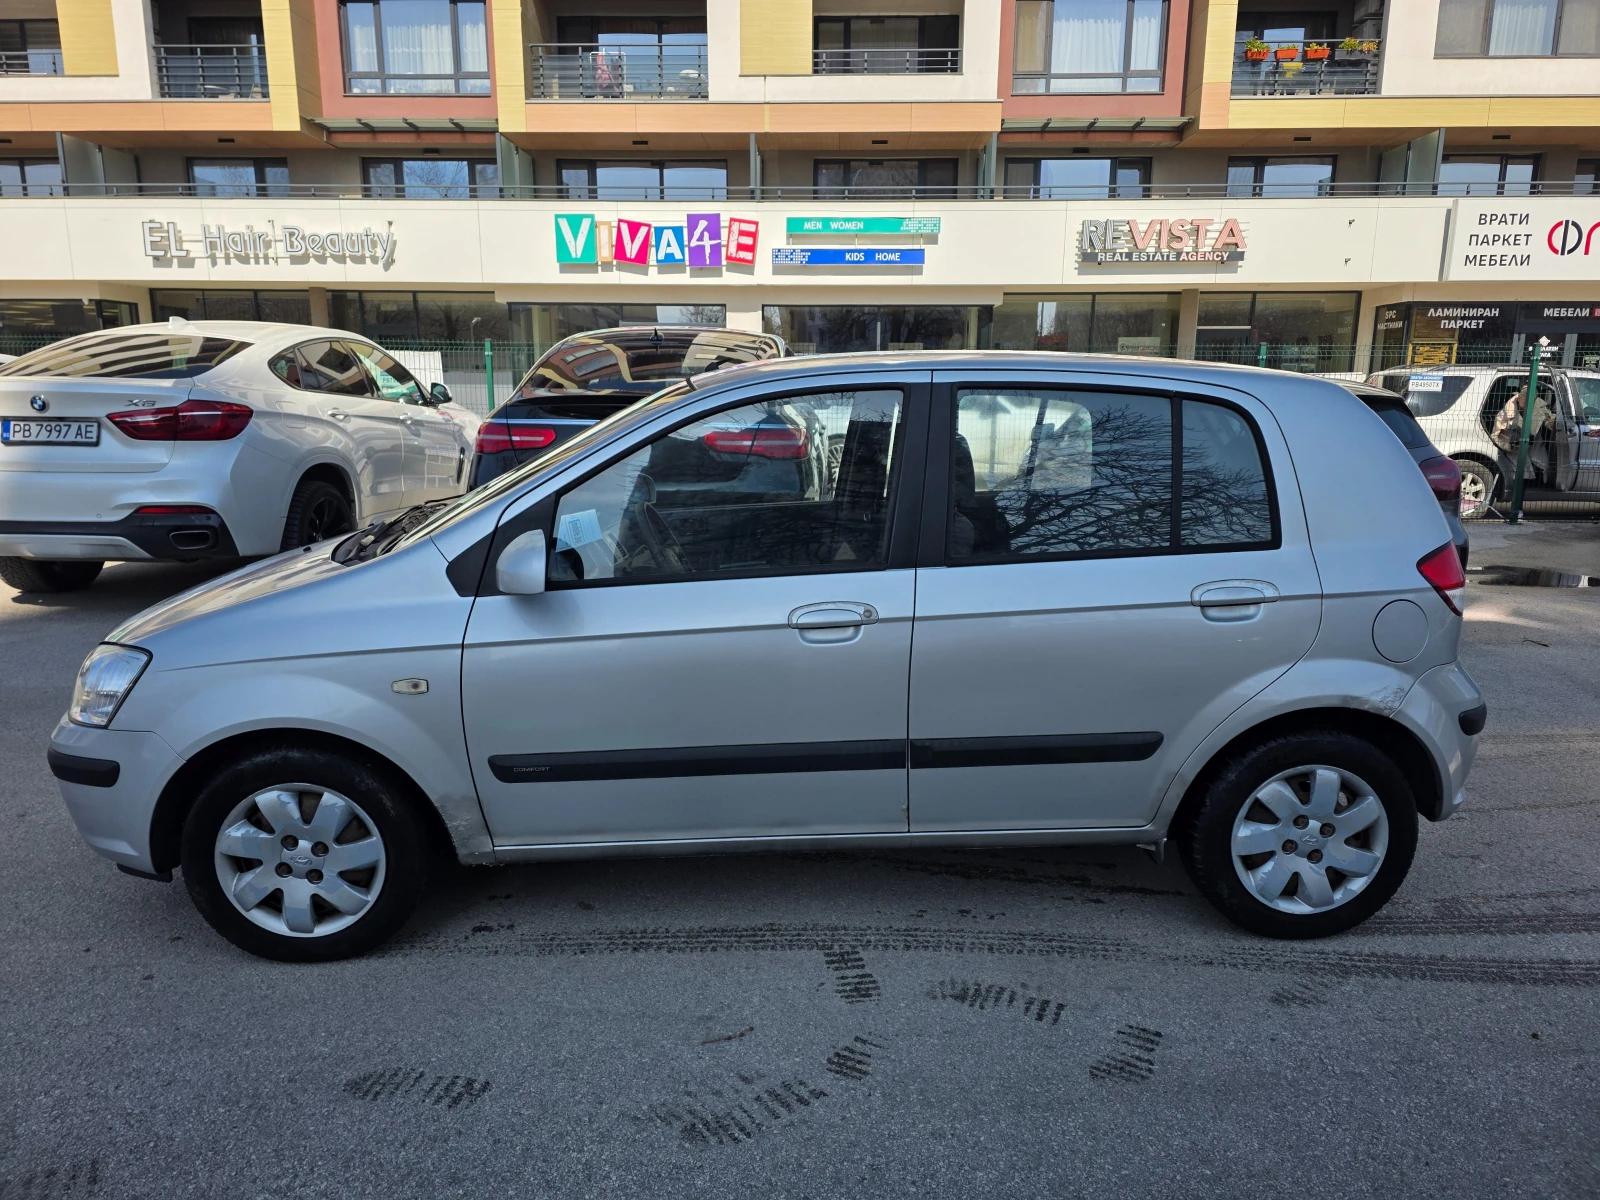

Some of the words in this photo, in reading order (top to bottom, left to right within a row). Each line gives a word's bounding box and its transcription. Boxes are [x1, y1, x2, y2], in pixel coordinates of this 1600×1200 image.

[1478, 213, 1530, 226] ВРАТИ
[803, 221, 823, 230] MEN
[830, 221, 864, 230] WOMEN
[1082, 218, 1247, 250] REVISTA
[142, 221, 188, 257] EL
[201, 224, 267, 256] Hair
[281, 225, 393, 263] Beauty
[1468, 233, 1533, 247] ПАРКЕТ
[845, 252, 865, 261] KIDS
[875, 252, 901, 261] HOME
[1097, 252, 1129, 262] REAL
[1132, 252, 1177, 262] ESTATE
[1179, 251, 1229, 262] AGENCY
[1464, 254, 1531, 267] МЕБЕЛИ
[1385, 310, 1397, 319] SPC
[1427, 307, 1500, 317] ЛАМИНИРАН
[1543, 307, 1590, 317] МЕБЕЛИ
[1440, 319, 1485, 329] ПАРКЕТ
[124, 399, 157, 407] X6
[12, 423, 32, 438] PB
[35, 423, 72, 439] 7997
[74, 424, 94, 440] AE
